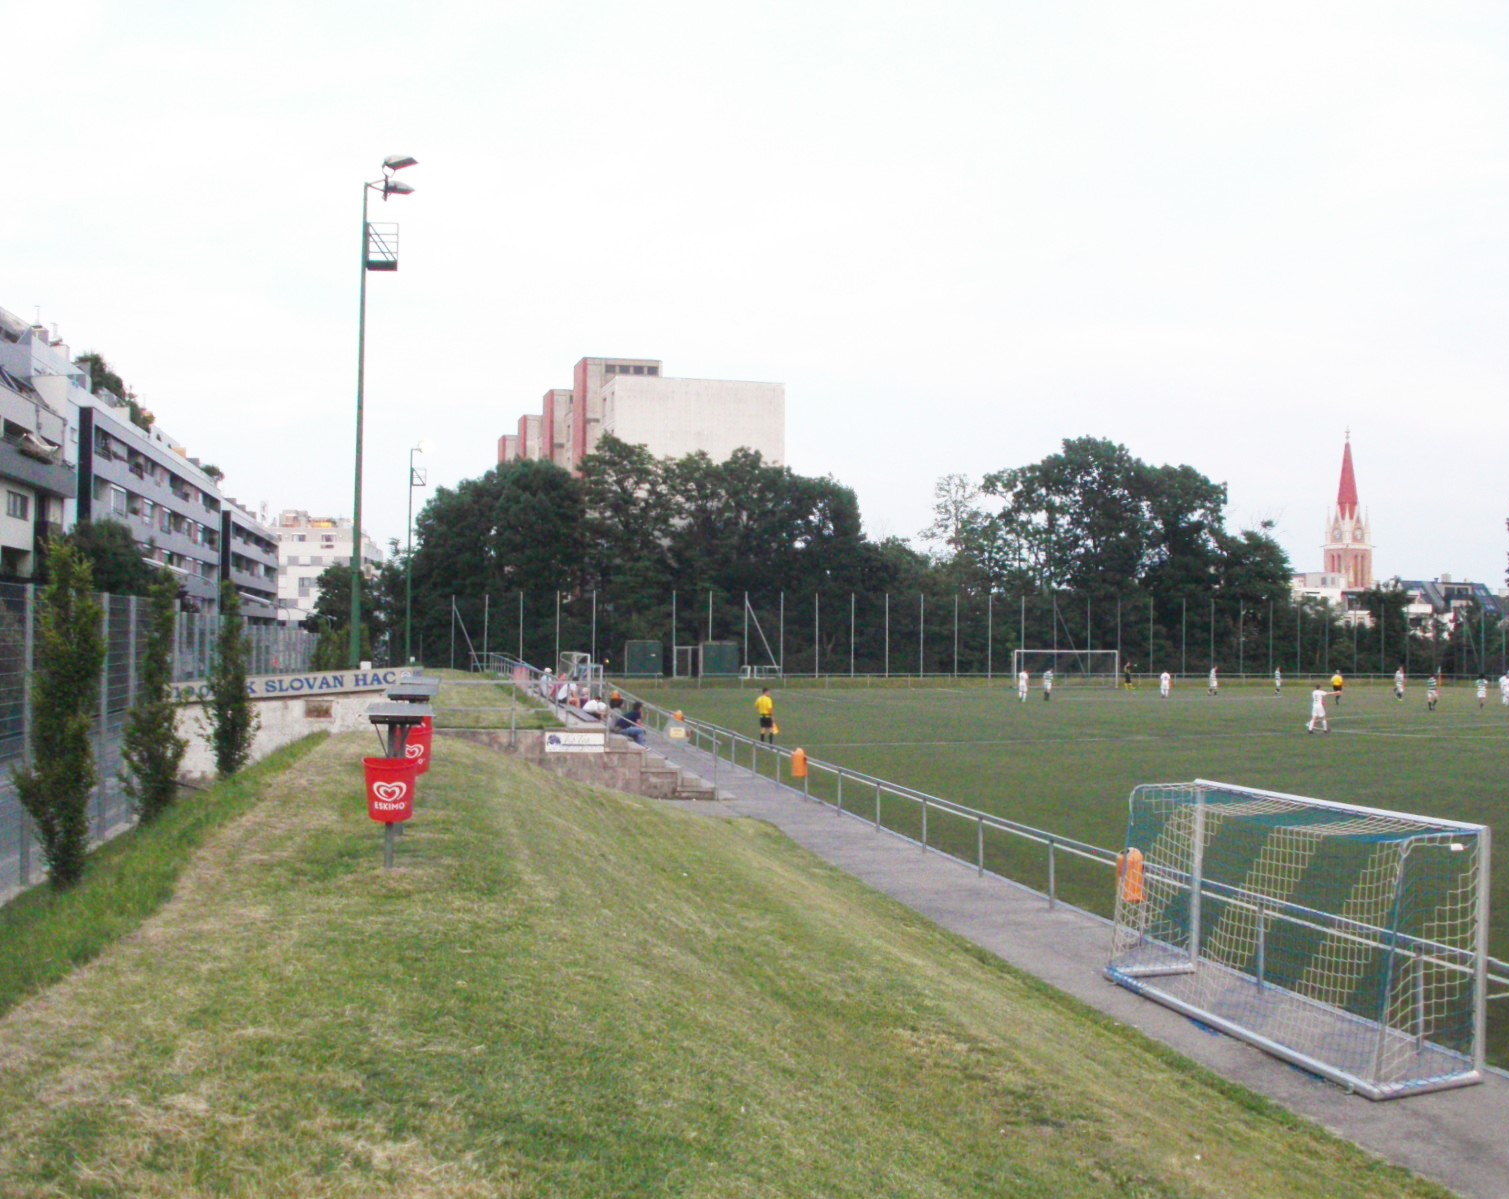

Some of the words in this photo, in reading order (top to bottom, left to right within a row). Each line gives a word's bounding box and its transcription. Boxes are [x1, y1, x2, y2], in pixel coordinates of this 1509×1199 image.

[264, 674, 345, 694] SLOVAN
[354, 671, 397, 687] HAC
[374, 801, 406, 811] ESKIMO
